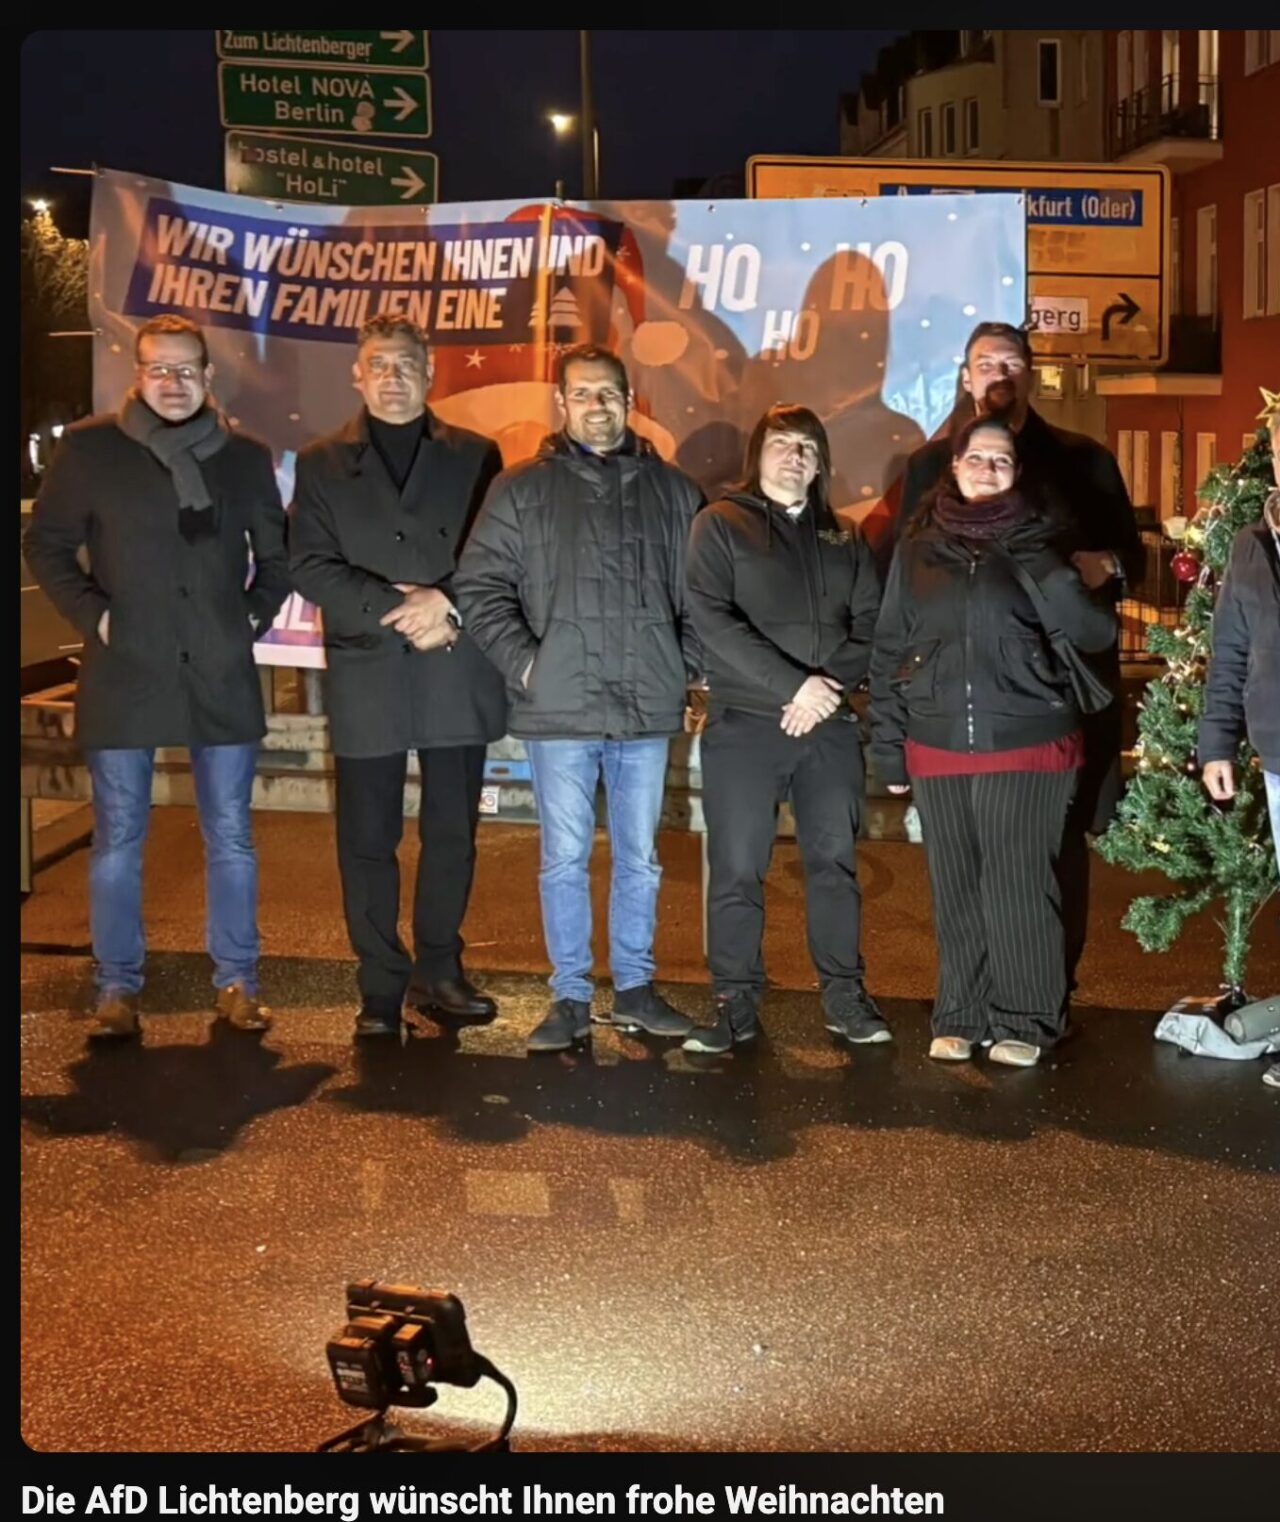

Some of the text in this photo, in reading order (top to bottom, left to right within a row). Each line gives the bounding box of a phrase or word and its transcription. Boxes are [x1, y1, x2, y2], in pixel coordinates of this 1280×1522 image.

[224, 30, 373, 60] Zum Lichtenberger
[240, 73, 375, 99] Hotel NOVA
[275, 101, 345, 124] Berlin
[1081, 194, 1136, 220] (Oder)
[157, 214, 235, 266] WIR
[243, 227, 437, 282] WÜNSCHEN
[441, 236, 534, 282] IHNEN
[147, 262, 270, 318] IHREN
[435, 287, 507, 330] EINE
[679, 241, 909, 312] HO HO
[759, 309, 820, 360] HO
